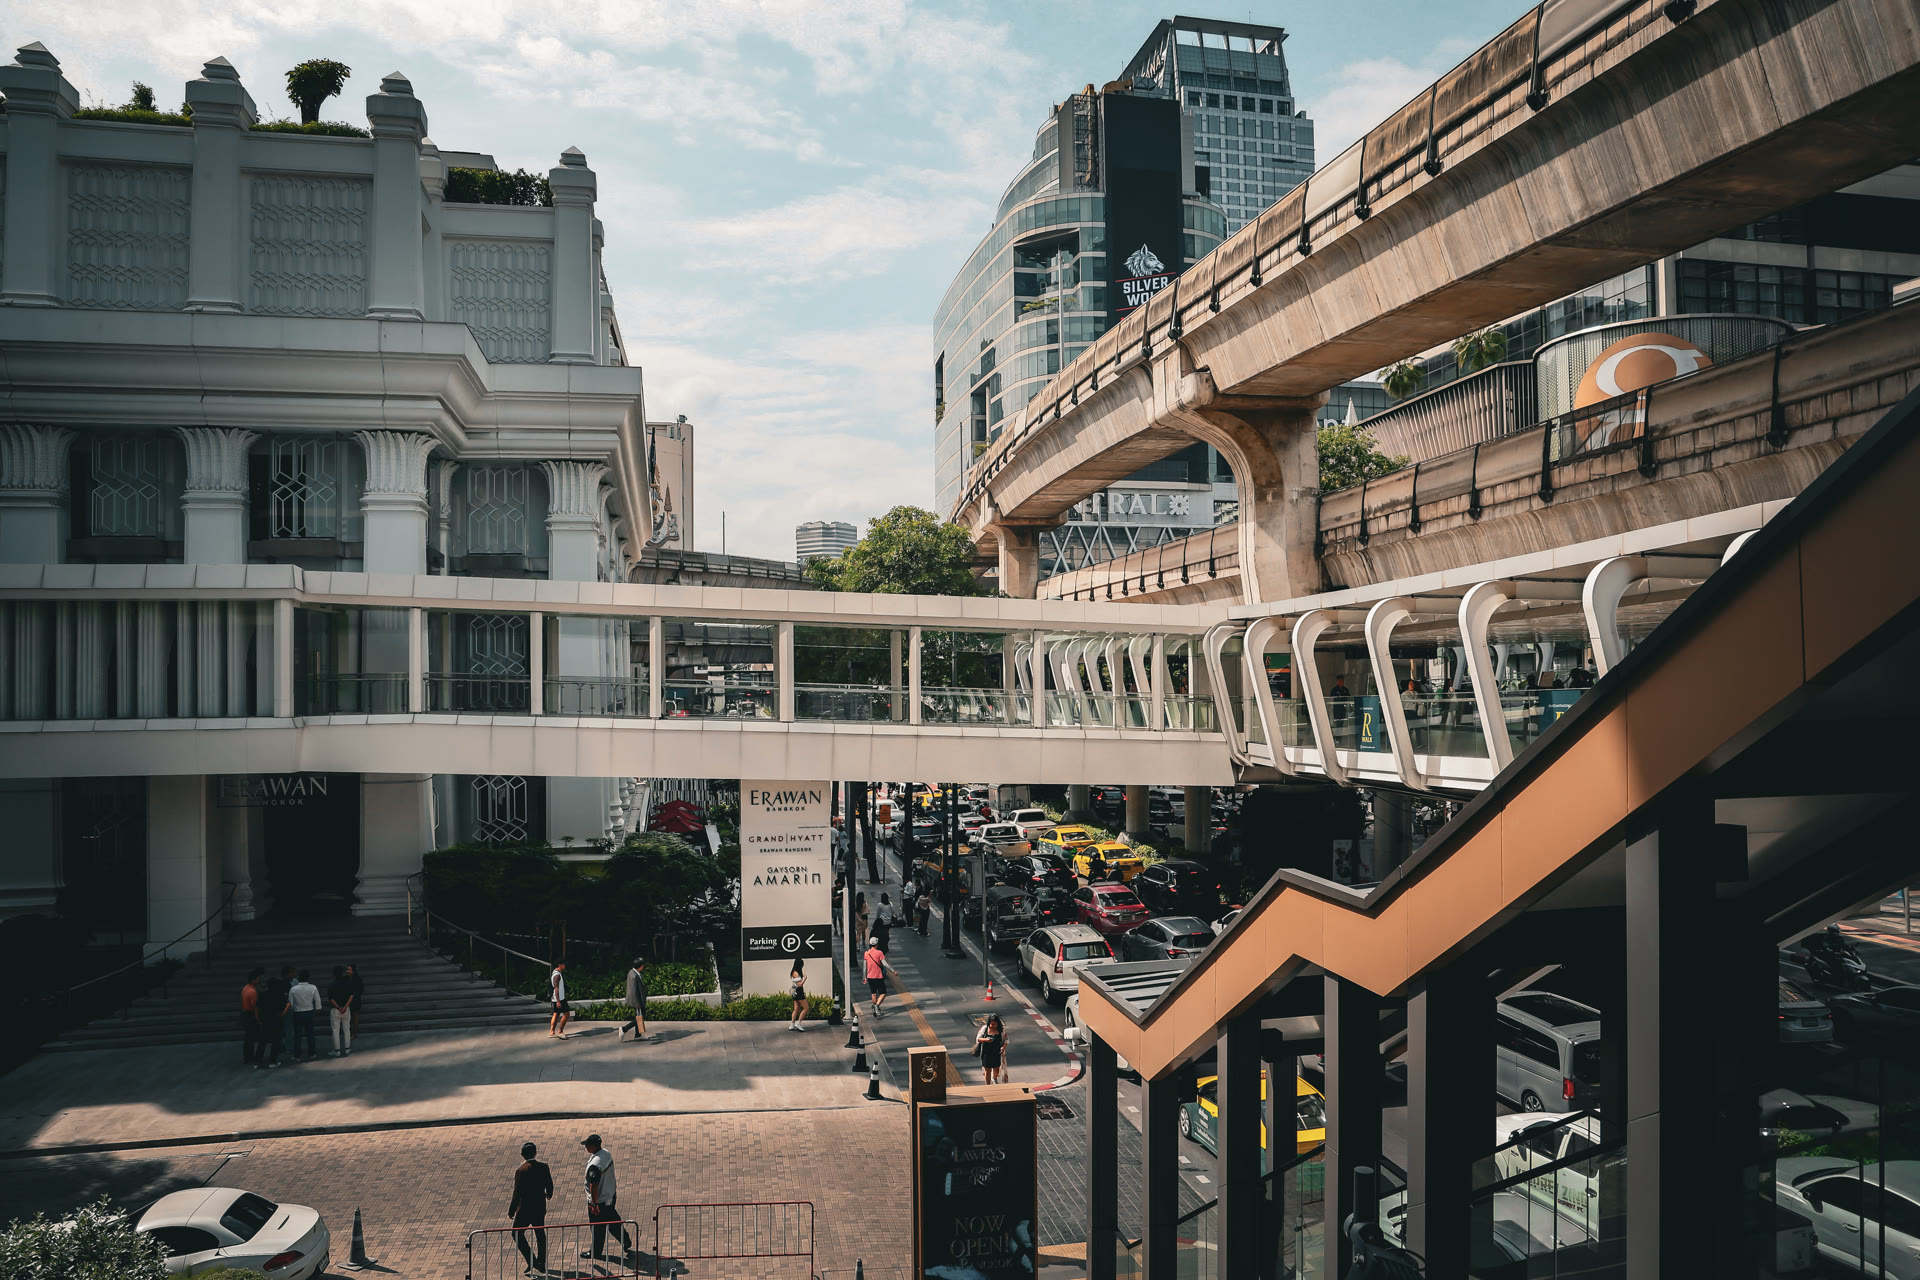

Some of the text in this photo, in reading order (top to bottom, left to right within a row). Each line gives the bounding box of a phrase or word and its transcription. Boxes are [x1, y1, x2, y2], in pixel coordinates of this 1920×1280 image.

[1123, 277, 1168, 294] SILVER
[1073, 492, 1168, 515] TRAL
[1362, 712, 1372, 737] R
[263, 798, 304, 806] NGKOK
[751, 790, 821, 807] ERAWAN
[748, 834, 824, 843] GRAND HYATT
[766, 866, 808, 874] GAYSORN
[749, 938, 778, 947] Parking
[953, 1214, 1007, 1236] NOW
[950, 1232, 1009, 1258] OPEN!
